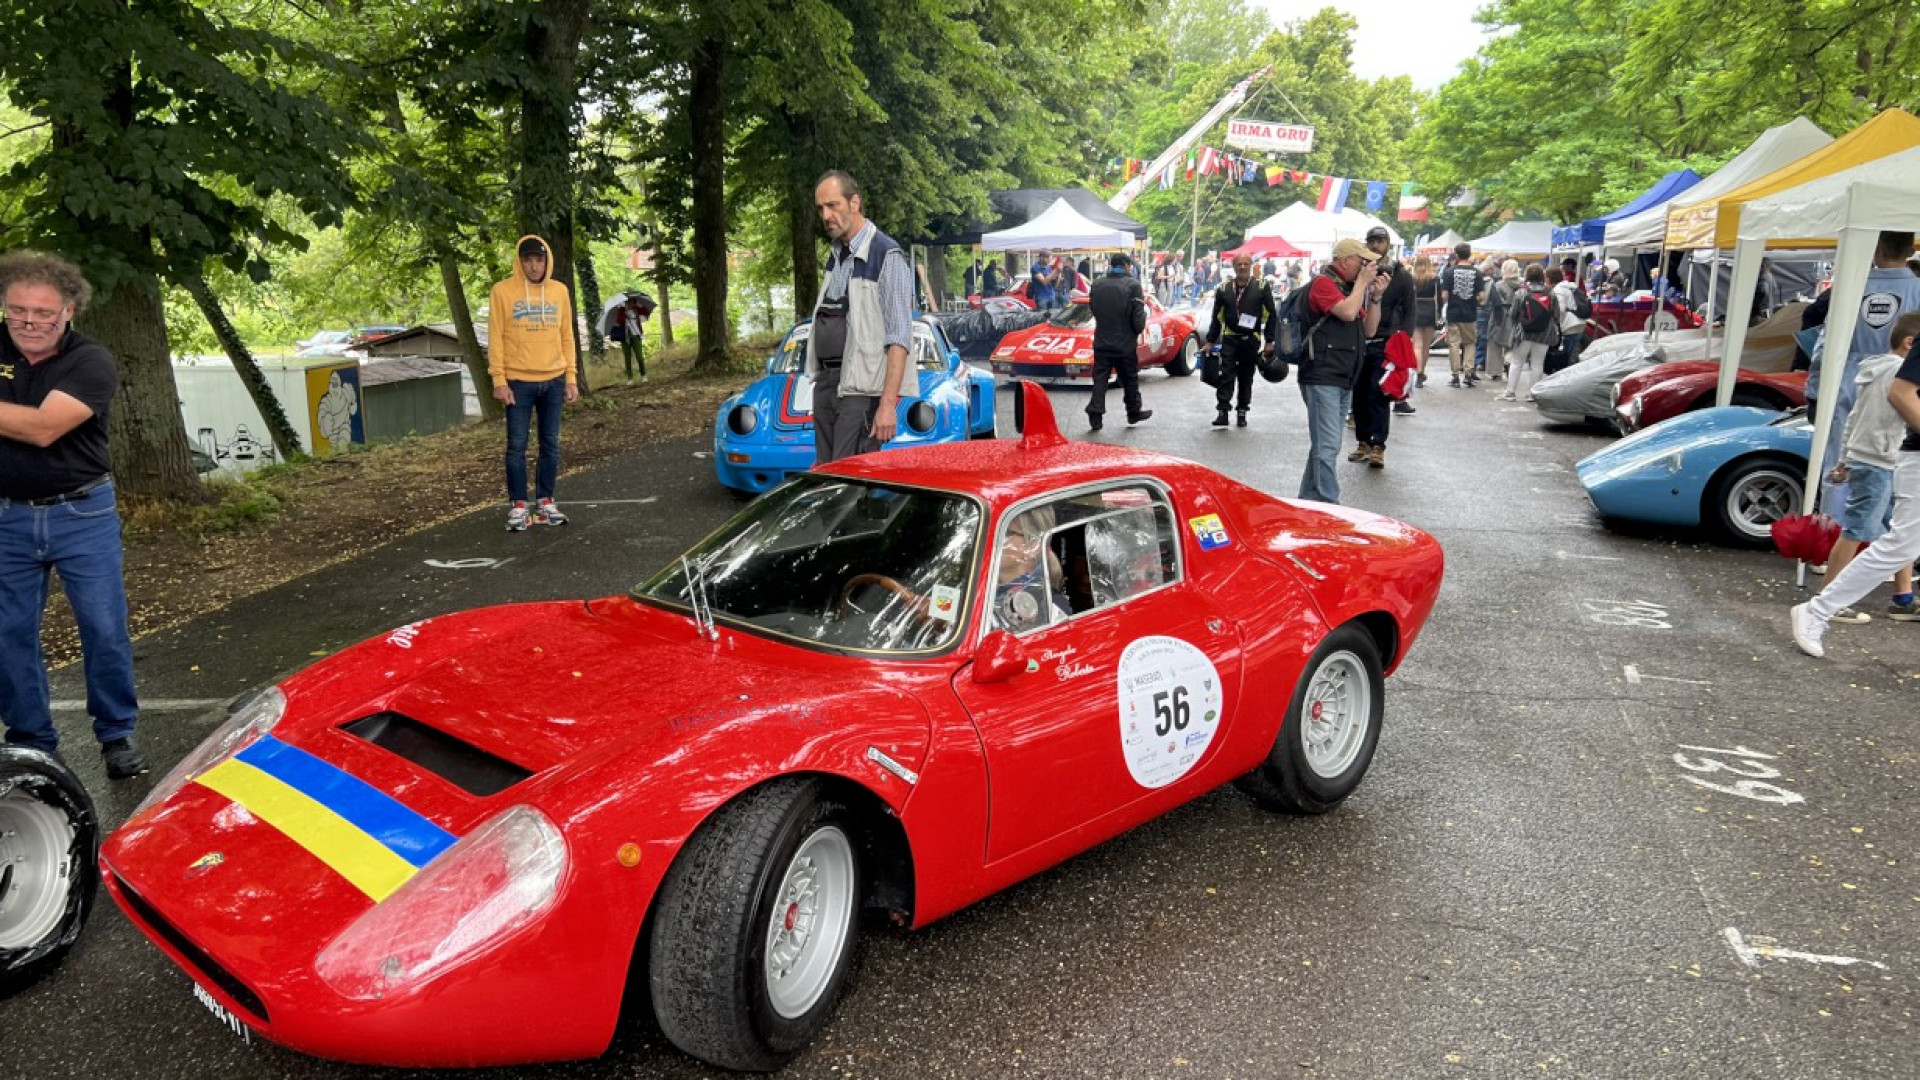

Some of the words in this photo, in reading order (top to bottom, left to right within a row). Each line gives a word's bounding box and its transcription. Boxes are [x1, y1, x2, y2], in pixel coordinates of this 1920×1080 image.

[1231, 123, 1272, 137] IRMA
[1276, 127, 1309, 141] GRU
[1027, 337, 1075, 350] CIA
[1153, 685, 1190, 737] 56
